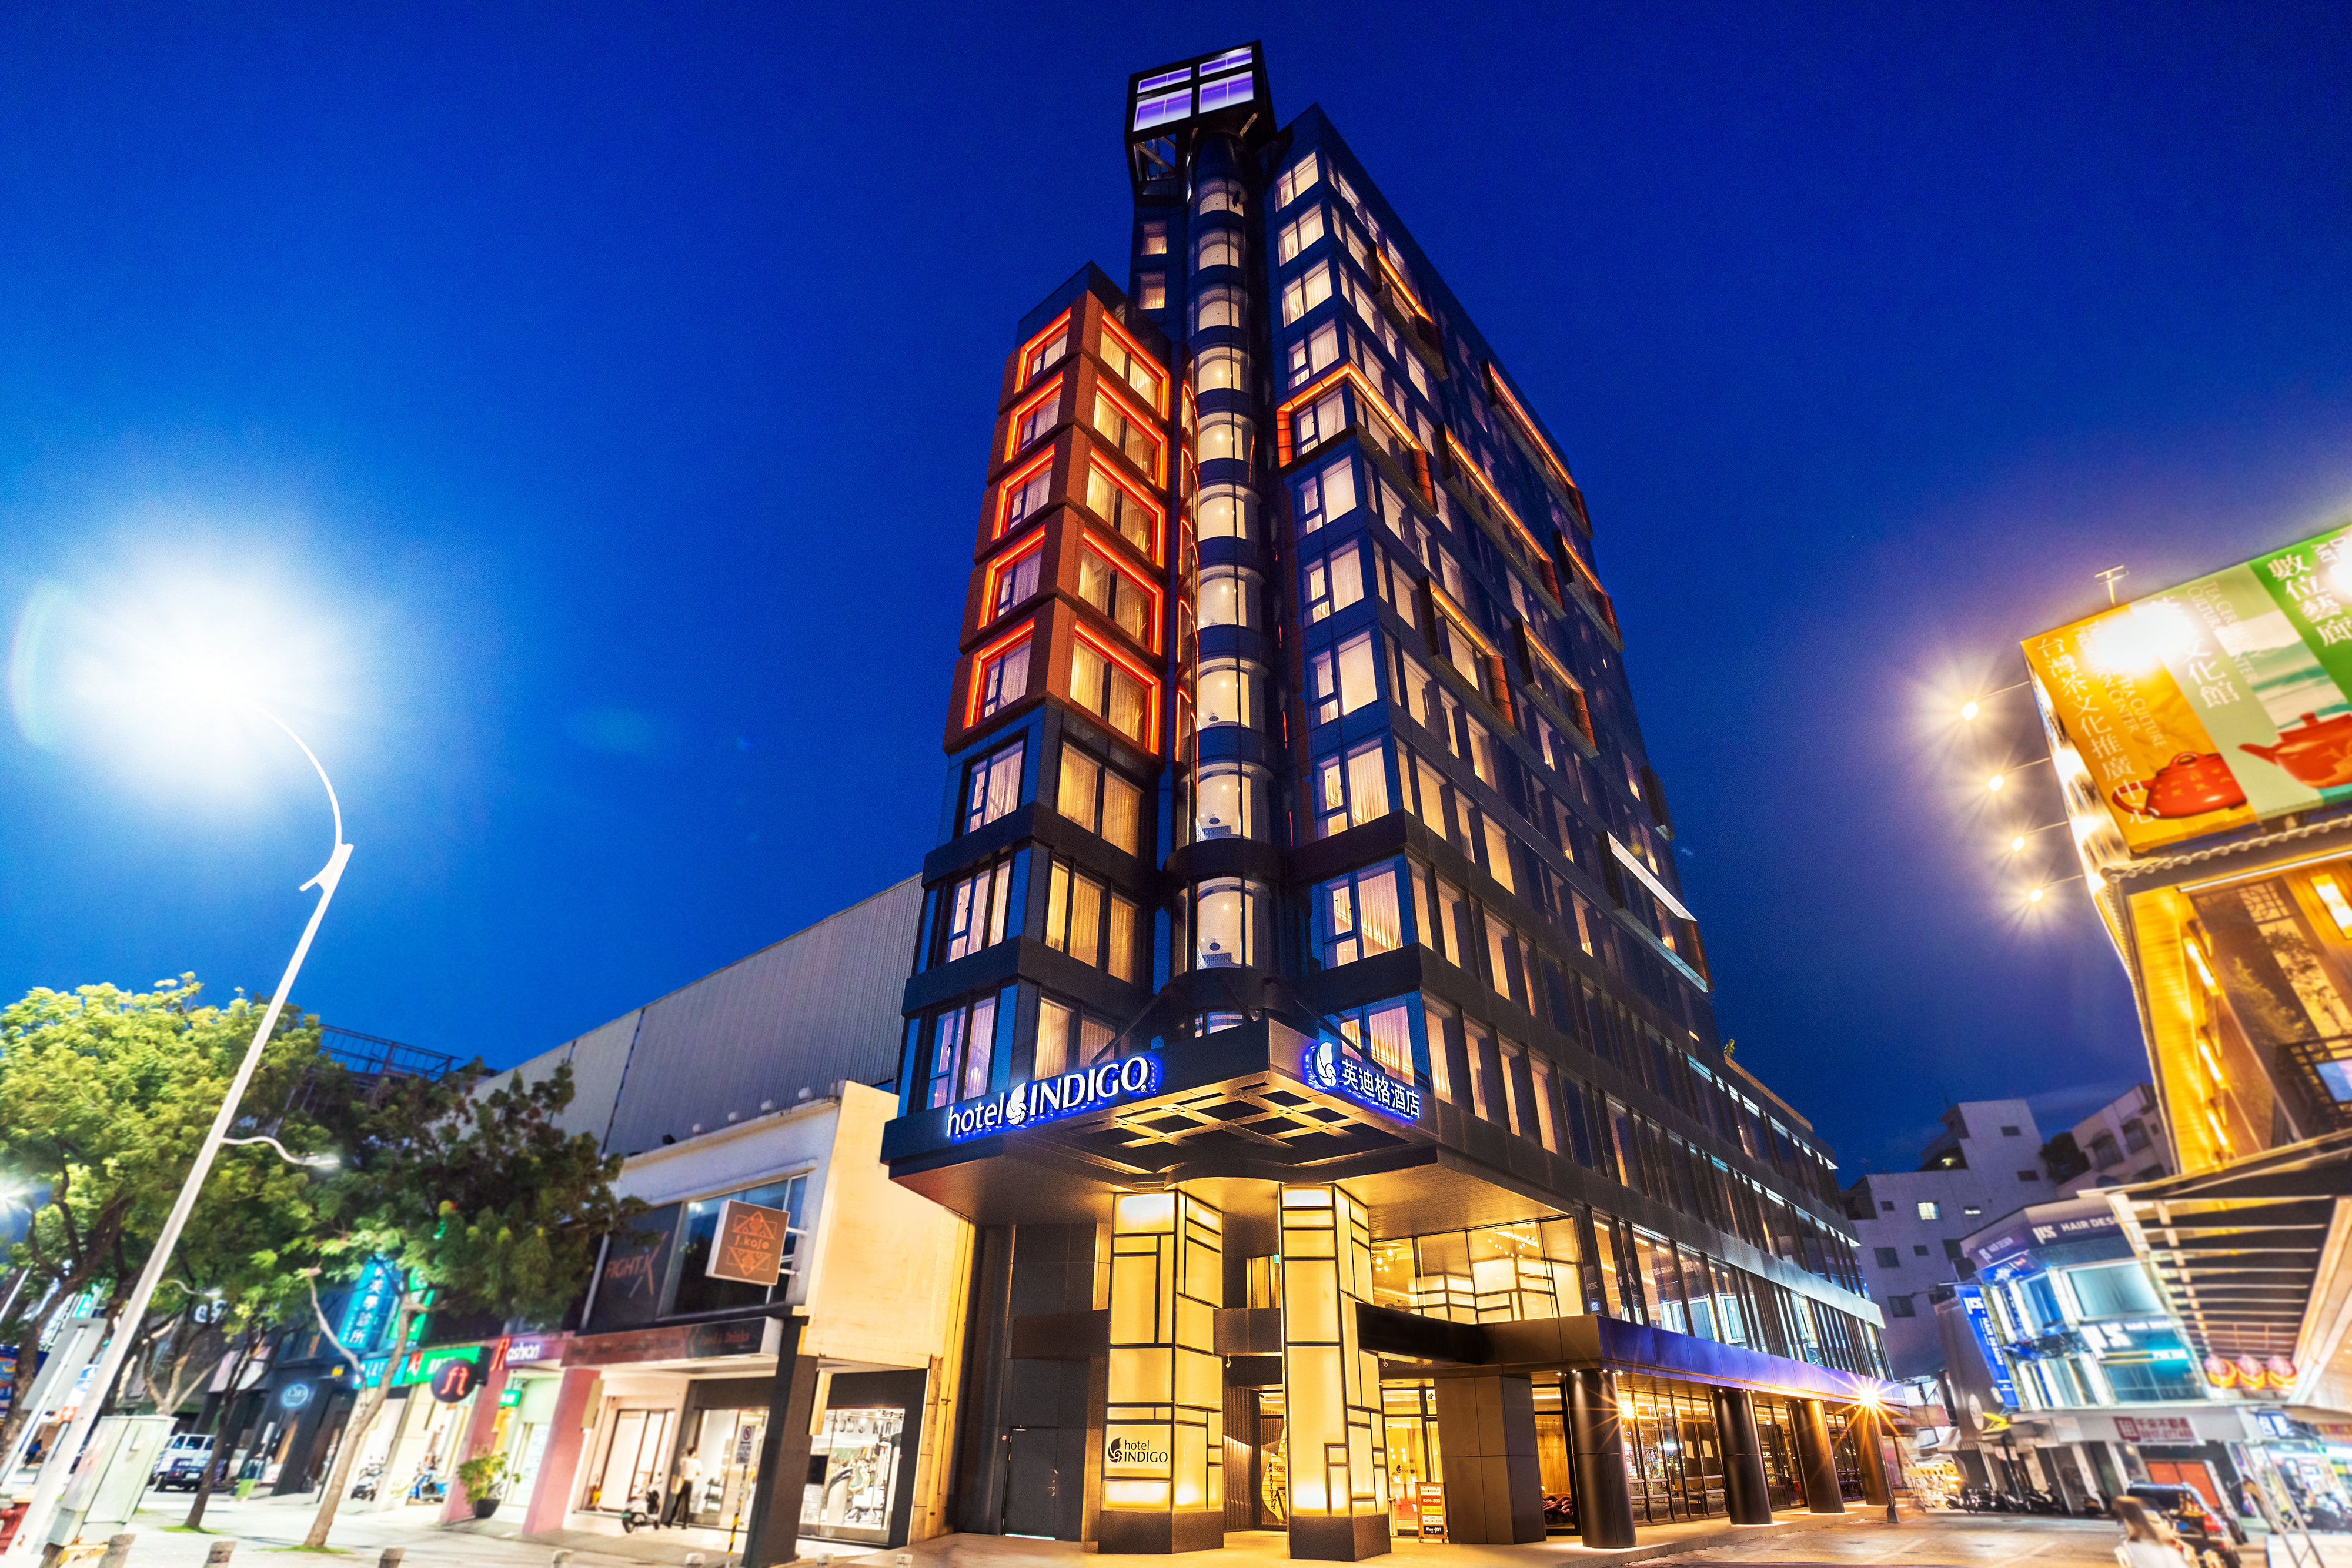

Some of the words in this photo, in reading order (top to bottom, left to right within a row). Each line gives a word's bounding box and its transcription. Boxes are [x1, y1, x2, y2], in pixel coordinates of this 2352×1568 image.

[2203, 580, 2222, 601] TEA
[2216, 600, 2265, 659] CERMONY
[2073, 626, 2116, 688] PROMION
[2109, 690, 2140, 734] CENTER
[2225, 637, 2259, 685] CNTER
[2037, 638, 2161, 824] 台灣茶文化推廣中心
[2118, 675, 2137, 698] TEA
[2130, 697, 2168, 748] CULTURE
[946, 1092, 1005, 1137] hotel
[1030, 1056, 1150, 1116] INDIGO
[1341, 1058, 1420, 1119] 英迪格酒店
[2060, 1220, 2089, 1232] HAIR
[1982, 1318, 1994, 1336] HAIR
[1989, 1336, 2004, 1366] DESIGN
[1124, 1439, 1150, 1450] hotel
[1124, 1451, 1168, 1463] INDIGO
